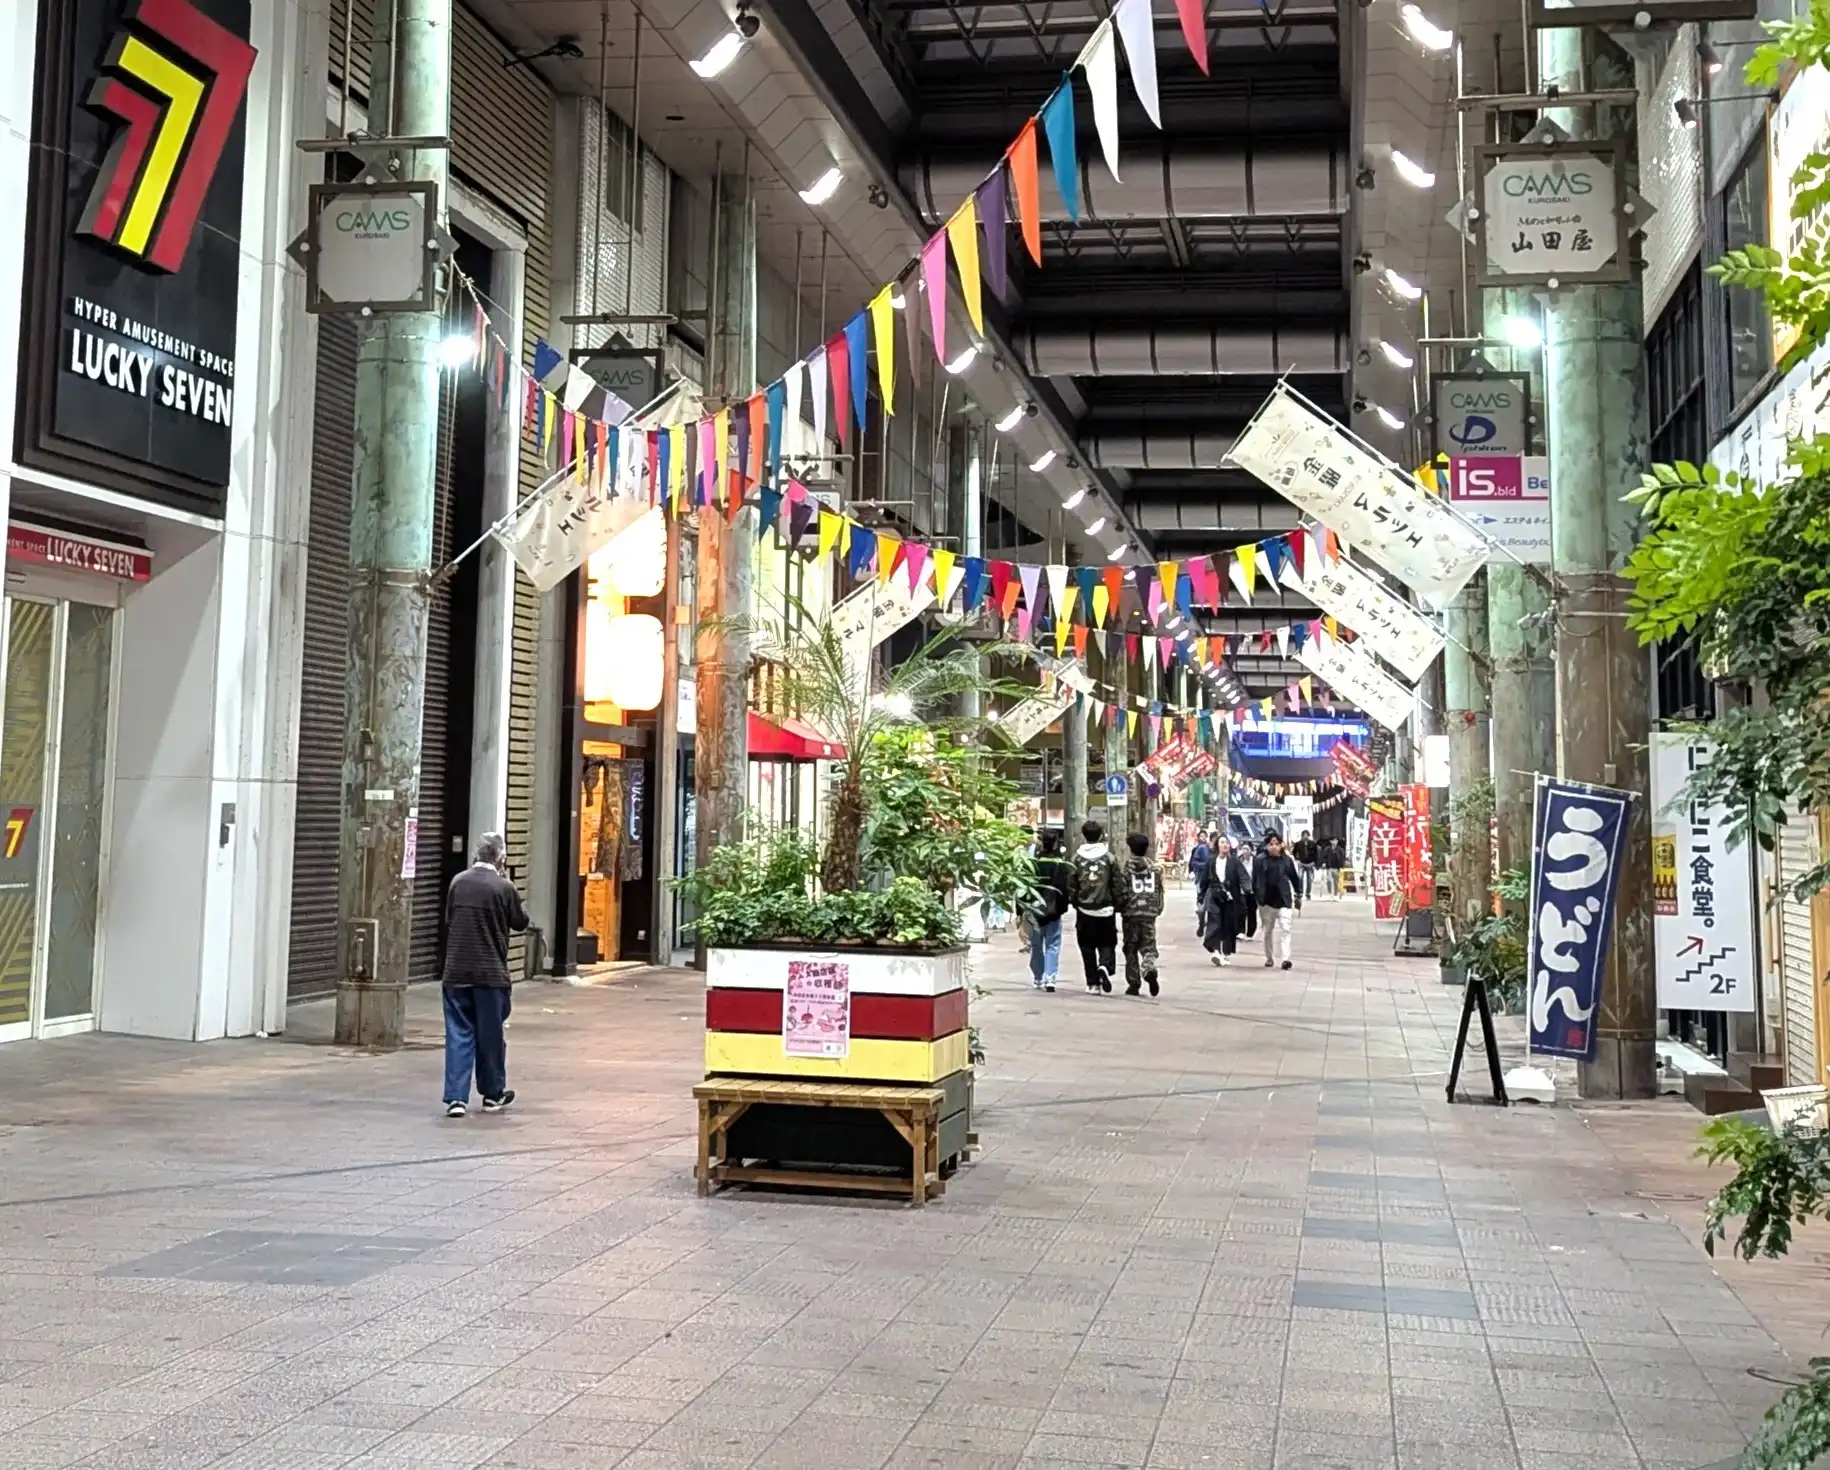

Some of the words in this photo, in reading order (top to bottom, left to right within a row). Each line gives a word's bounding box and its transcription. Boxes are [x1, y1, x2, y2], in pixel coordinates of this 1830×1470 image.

[1503, 173, 1592, 196] CAMS
[335, 211, 411, 232] CAMS
[1511, 229, 1594, 253] 山田屋
[74, 296, 117, 331] HYPER
[122, 317, 196, 358] AMUSEMENT
[199, 349, 235, 377] SPACE
[71, 328, 153, 398] LUCKY
[161, 364, 232, 427] SEVEN
[1451, 393, 1511, 409] CAMS
[47, 536, 91, 569] LUCKY
[93, 547, 136, 579] SEVEN
[1688, 746, 1716, 929] ににこ食堂。
[1532, 806, 1608, 1033] うどん
[1709, 973, 1737, 995] 2F
